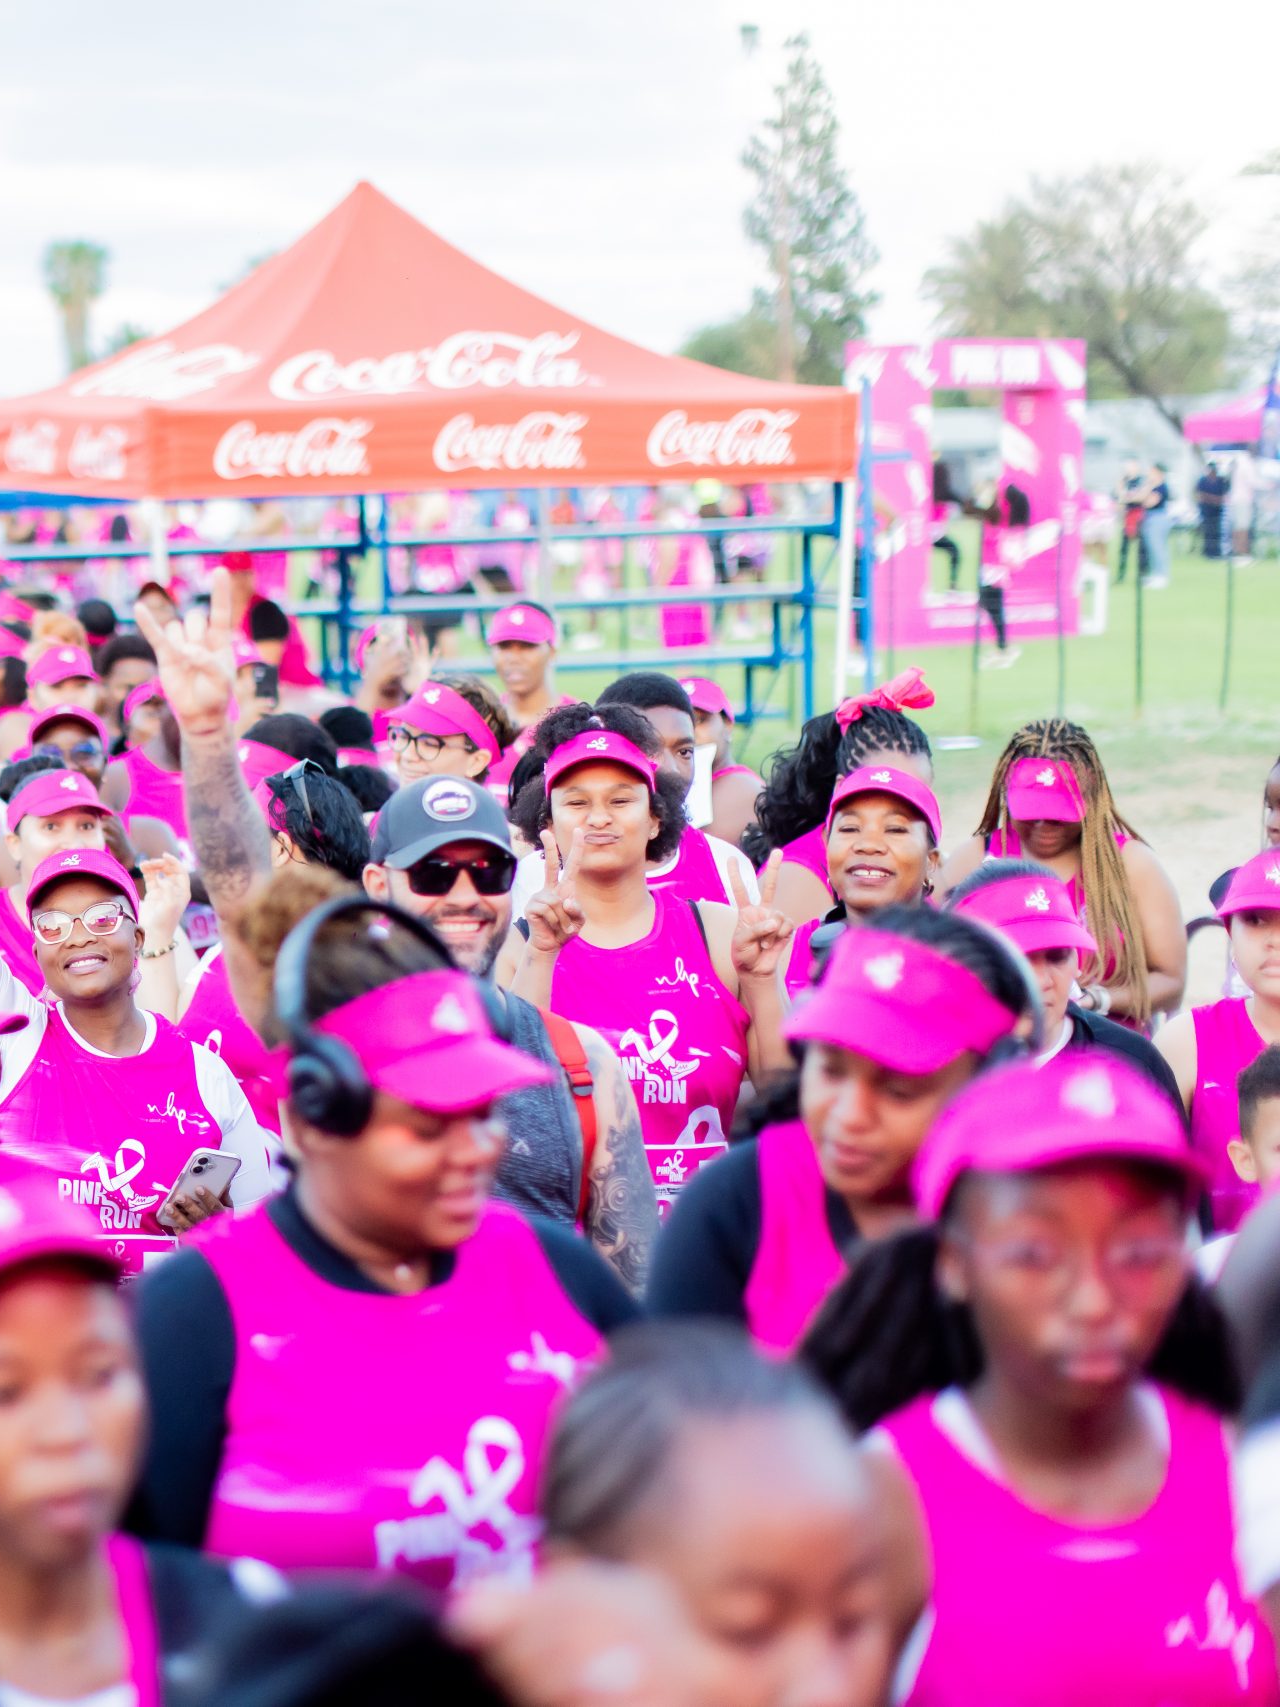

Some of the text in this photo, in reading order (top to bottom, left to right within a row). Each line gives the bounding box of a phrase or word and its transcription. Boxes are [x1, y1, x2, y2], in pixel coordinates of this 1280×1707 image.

[269, 330, 588, 400] Coca-Cola
[214, 418, 375, 479] Coca-Cola
[433, 411, 590, 472] Coca-Cola
[647, 408, 800, 467] Coca-Cola
[655, 956, 700, 998] nhp
[643, 1076, 687, 1104] RUN
[147, 1091, 187, 1135] nhp
[58, 1178, 108, 1206] PINK
[99, 1203, 143, 1229] RUN
